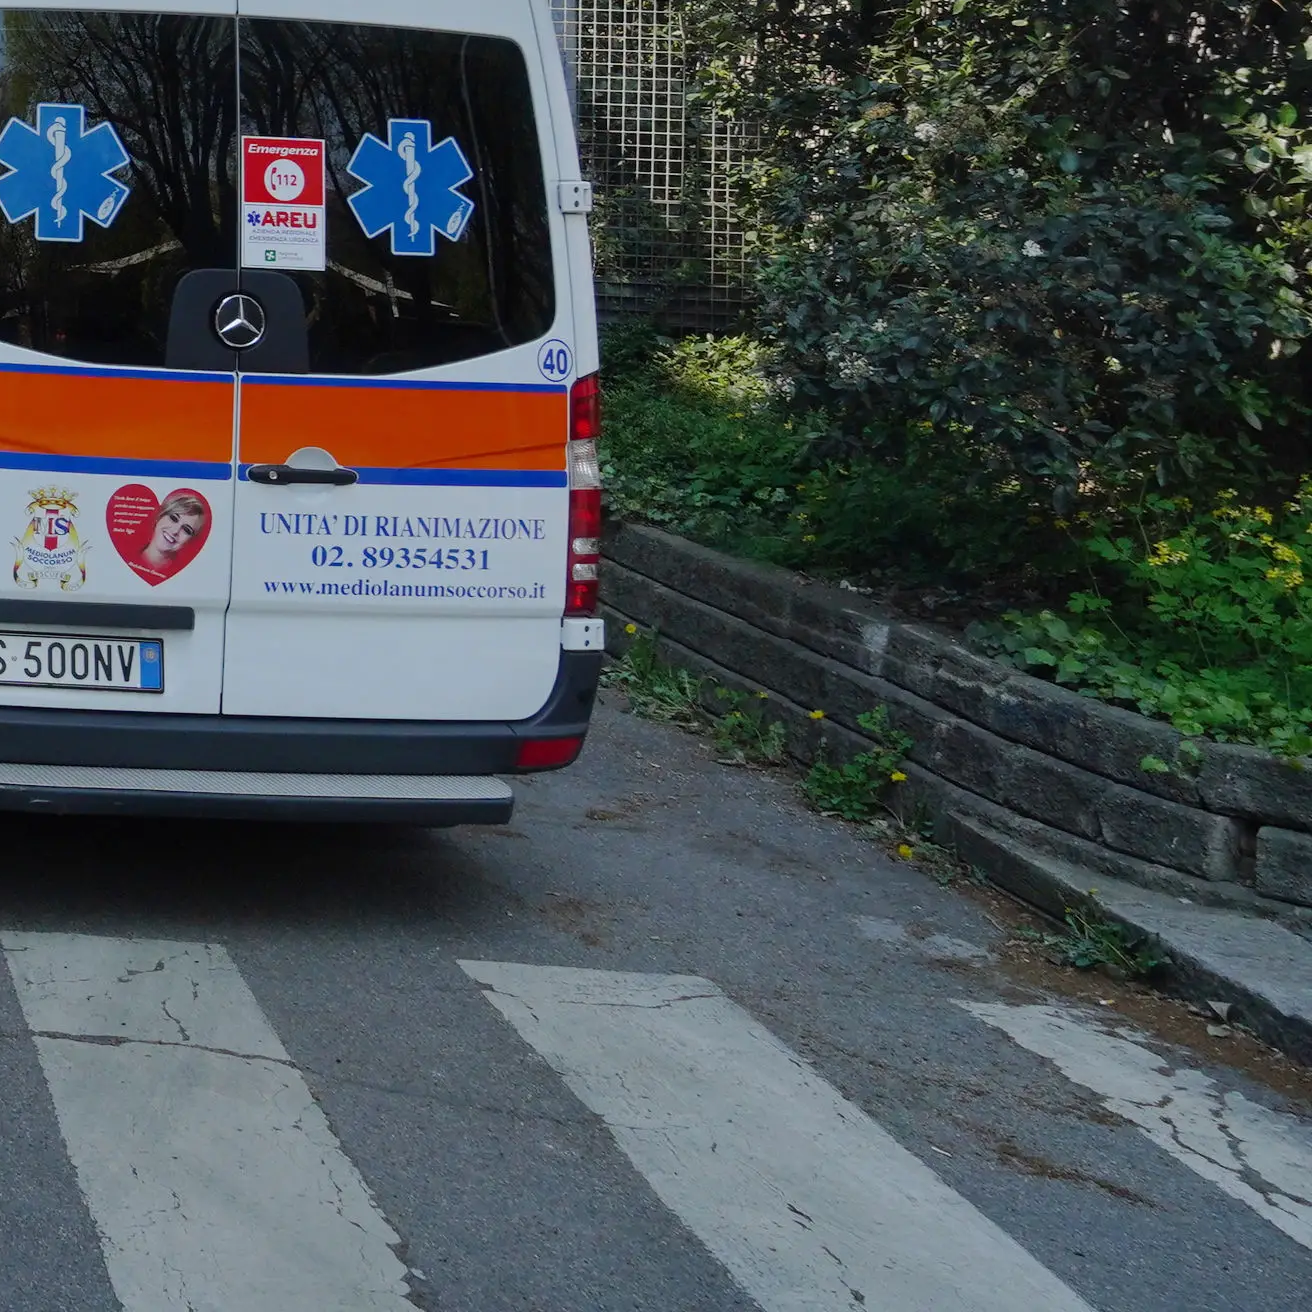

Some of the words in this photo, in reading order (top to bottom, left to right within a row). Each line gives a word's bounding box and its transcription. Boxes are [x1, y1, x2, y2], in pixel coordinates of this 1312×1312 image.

[247, 143, 319, 157] Emergenza
[276, 174, 297, 186] 112
[261, 210, 317, 229] AREU
[543, 348, 568, 375] 40
[260, 513, 339, 536] UNITA'
[343, 515, 368, 536] DI
[375, 515, 546, 540] RIANIMAZIONE
[25, 546, 76, 559] MEDIOLANUM
[27, 554, 73, 566] SOCCORSO
[311, 544, 353, 568] 02.
[361, 545, 490, 570] 89354531
[263, 578, 546, 599] www.mediolanumsoccorso.it
[23, 641, 136, 682] 500NV
